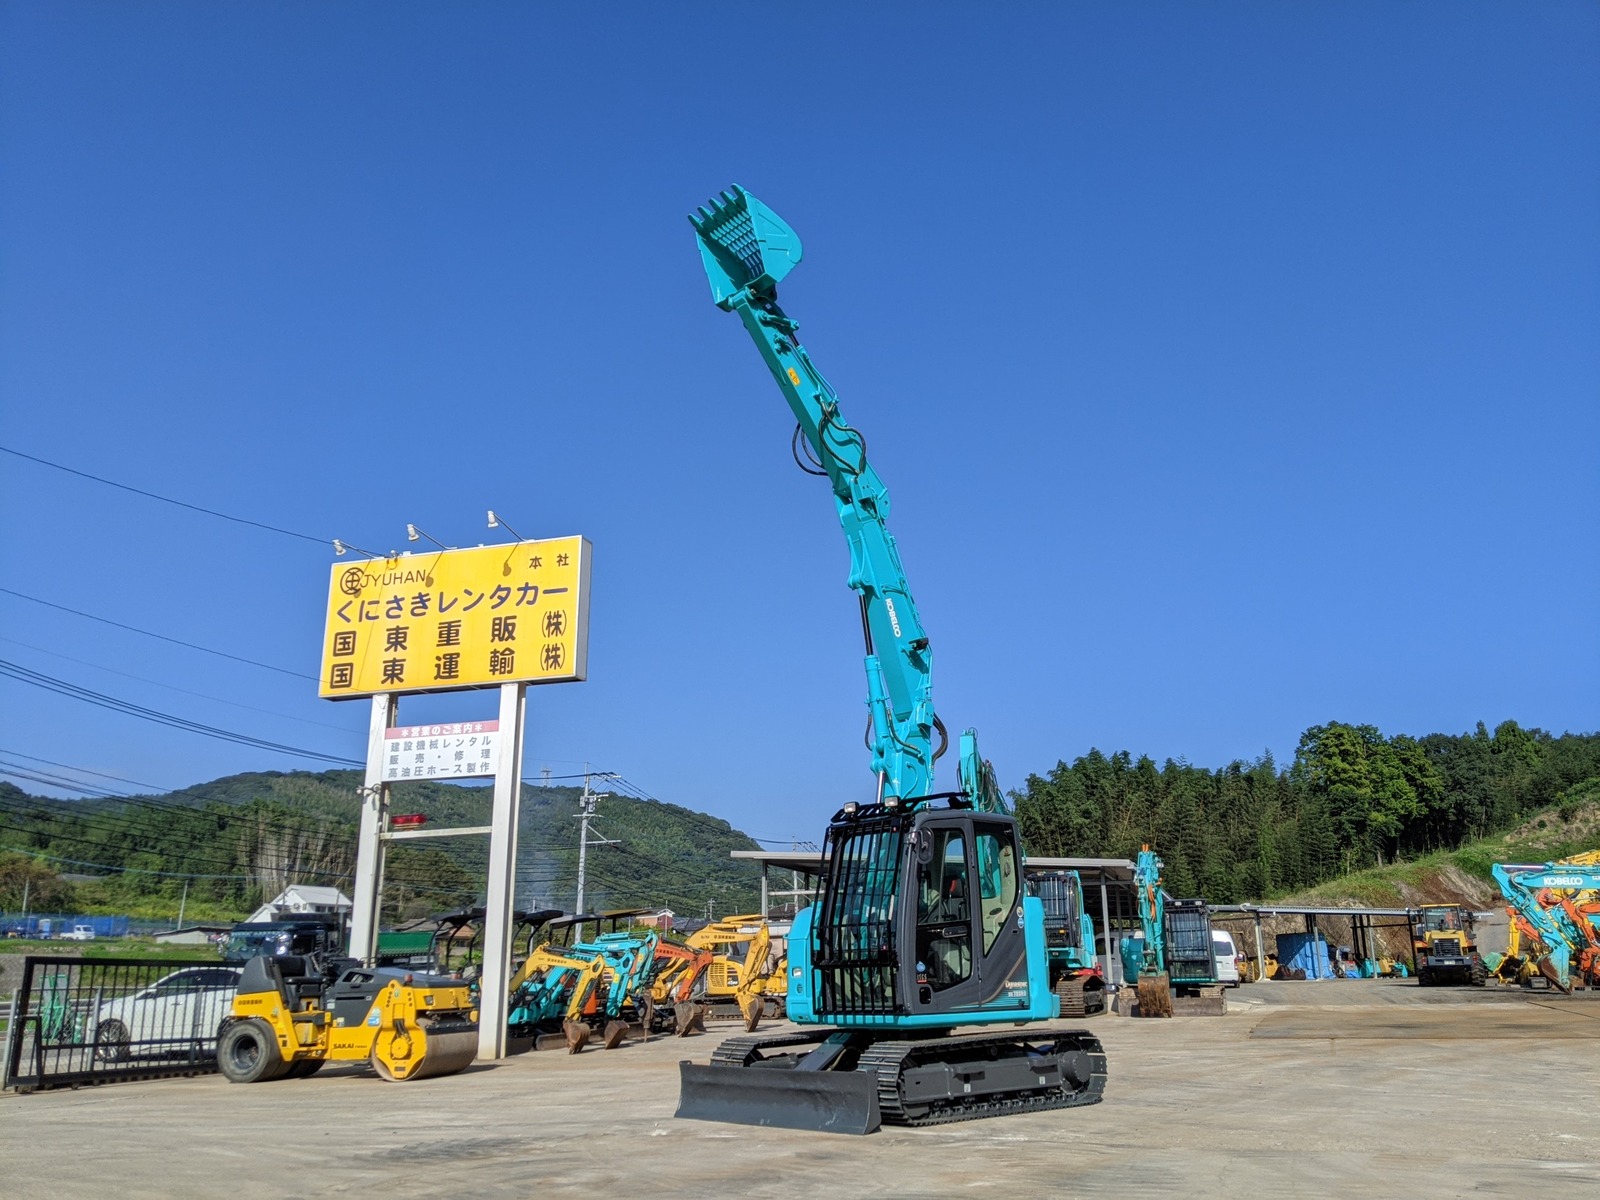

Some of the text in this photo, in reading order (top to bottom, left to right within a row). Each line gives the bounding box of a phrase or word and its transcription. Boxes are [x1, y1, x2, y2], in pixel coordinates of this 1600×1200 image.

[528, 553, 569, 570] 本社
[359, 569, 426, 588] JYUHAN
[336, 582, 569, 623] くにさきレンタカー
[885, 598, 902, 638] KOBELCO
[390, 735, 492, 753] 建設機械レンタル
[1543, 877, 1584, 886] KOBELCO
[333, 1042, 355, 1050] SAKAI
